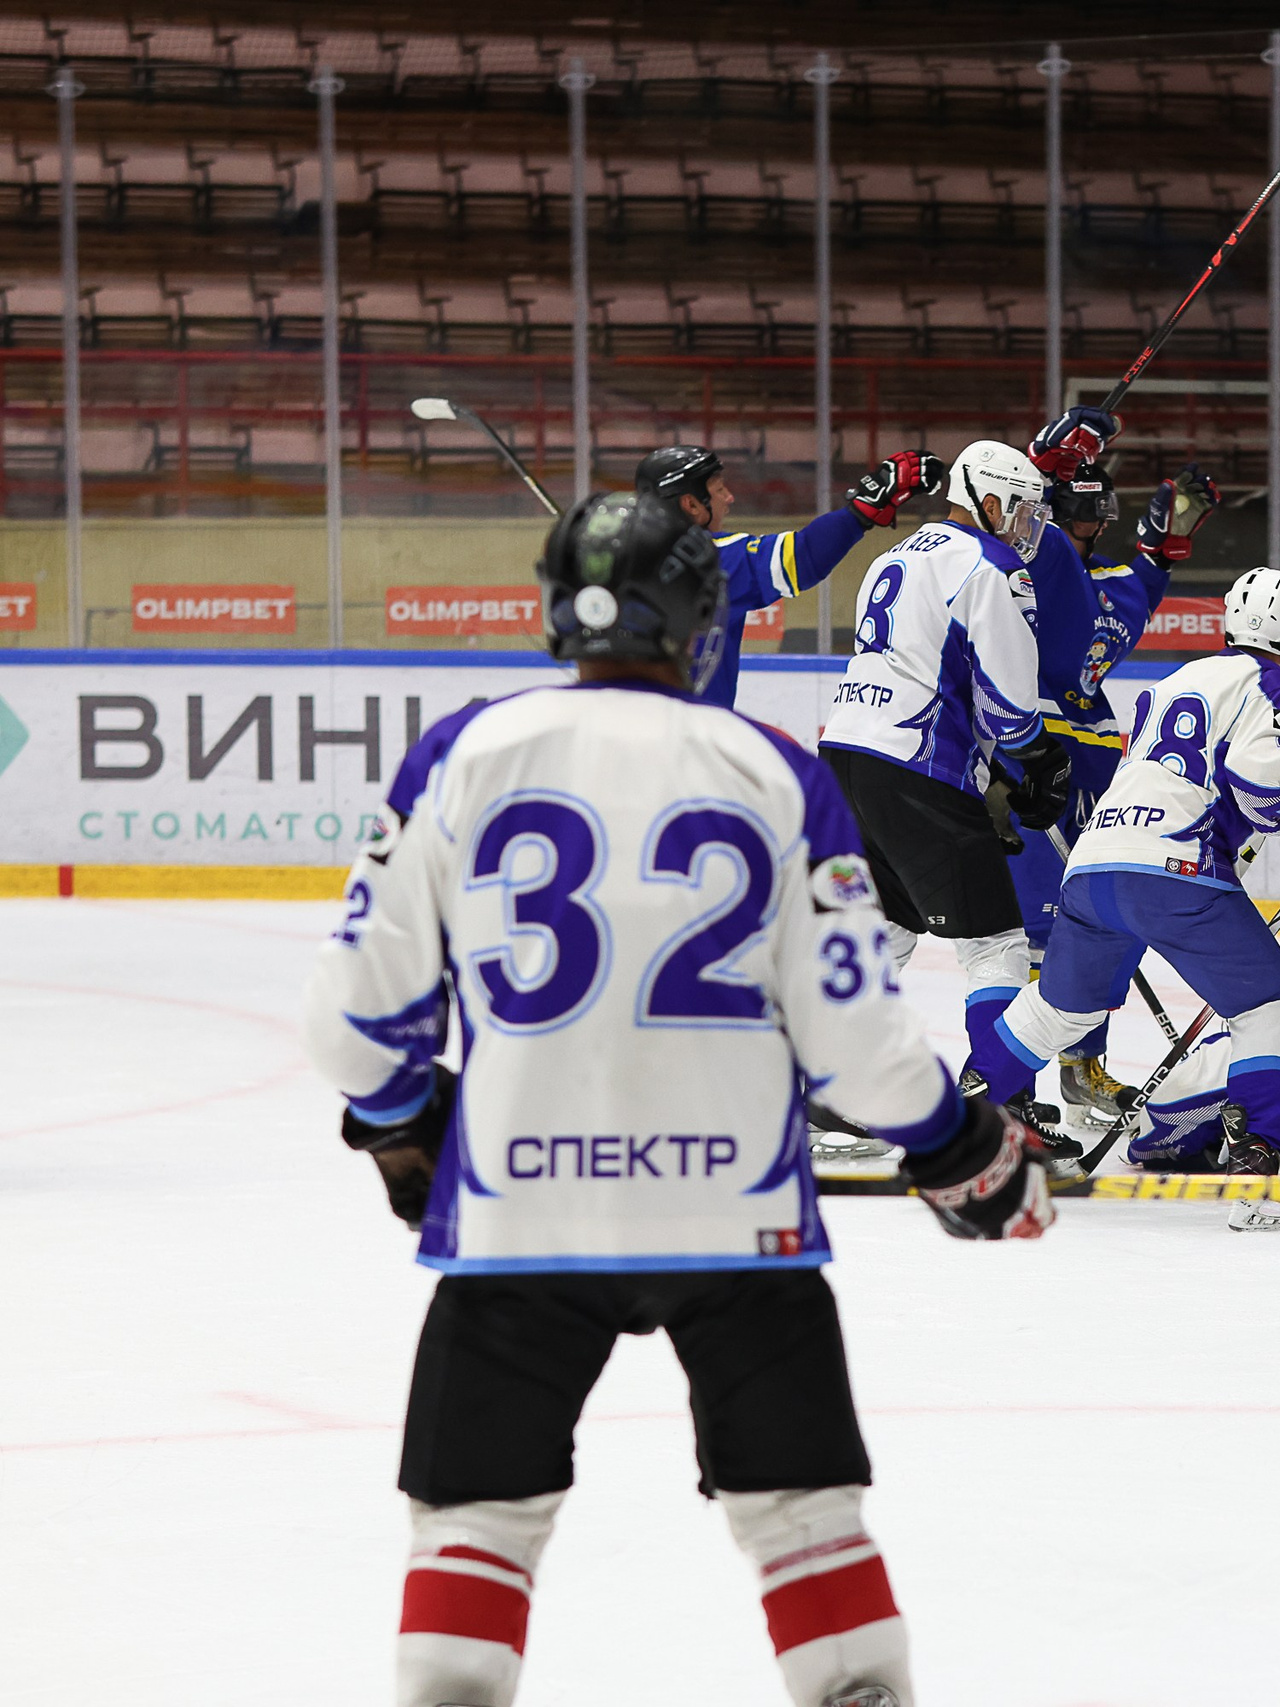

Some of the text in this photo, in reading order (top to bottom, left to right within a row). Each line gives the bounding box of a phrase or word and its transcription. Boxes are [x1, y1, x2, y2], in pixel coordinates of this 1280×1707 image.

[135, 598, 291, 620] OLIMPBET
[389, 600, 540, 622] OLIMPBET
[1147, 614, 1226, 635] MPBET
[464, 788, 784, 1035] 32
[1112, 1065, 1169, 1131] VAPOR
[506, 1133, 739, 1180] СПЕКТР
